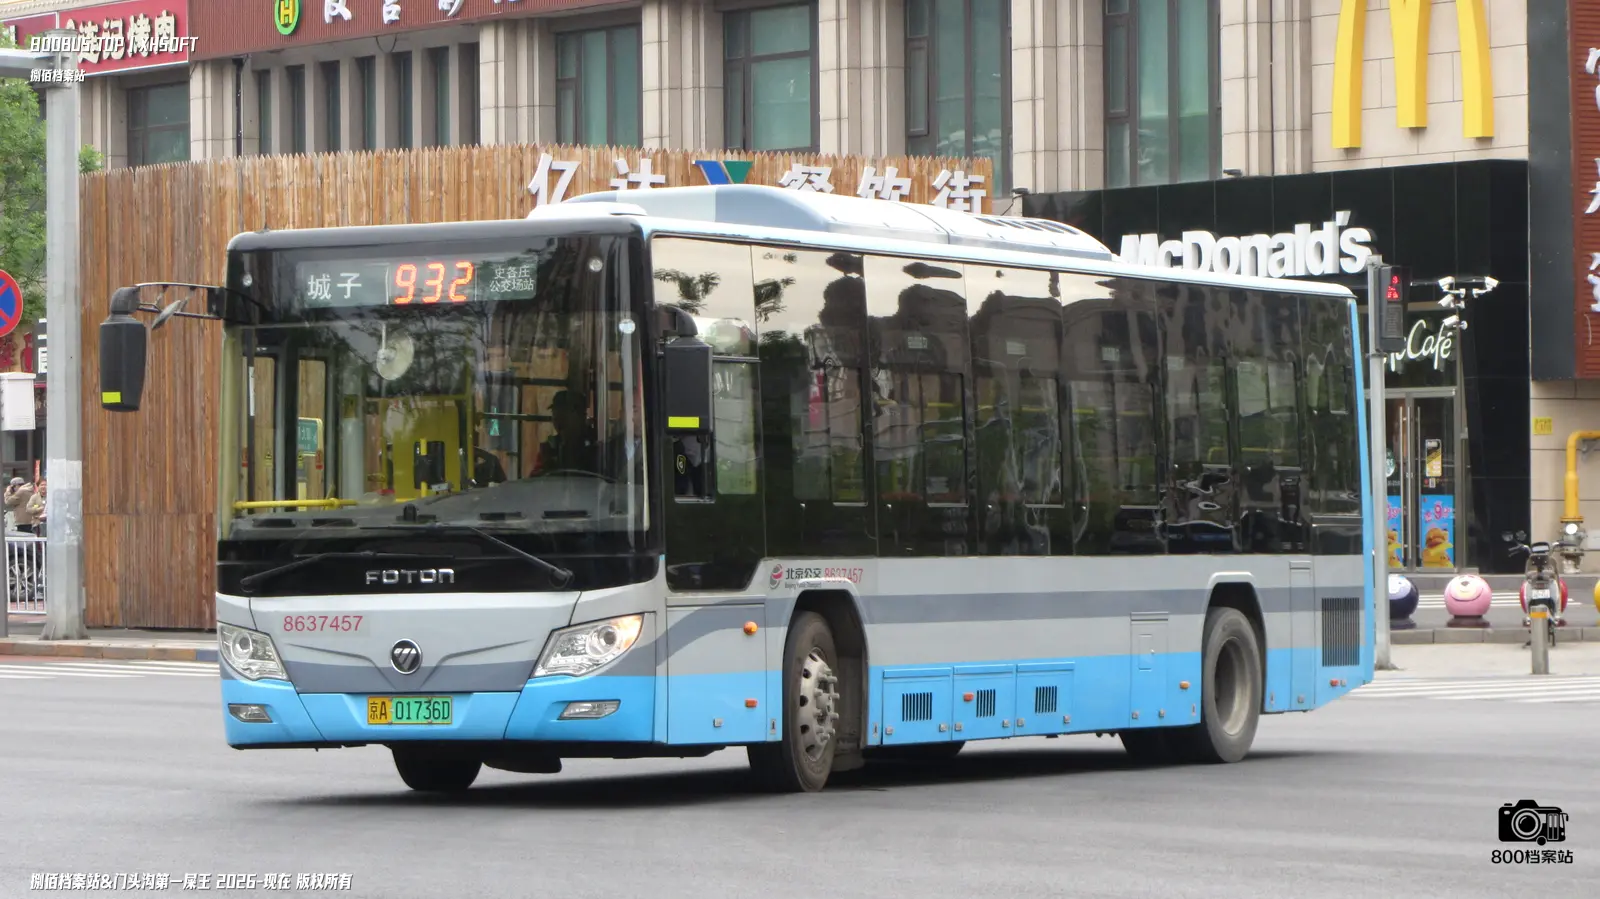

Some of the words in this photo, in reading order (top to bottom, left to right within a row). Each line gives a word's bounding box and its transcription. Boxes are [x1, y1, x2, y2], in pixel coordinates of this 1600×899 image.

[1119, 210, 1374, 279] McDonald's
[494, 264, 530, 279] 史各庄
[307, 272, 362, 300] 城子
[394, 261, 475, 304] 932
[489, 278, 535, 293] 公交场站
[365, 568, 455, 585] FOTON
[785, 567, 822, 580] 北京公交
[824, 567, 864, 584] 8637457
[283, 615, 364, 632] 8637457
[395, 700, 450, 721] 01736D
